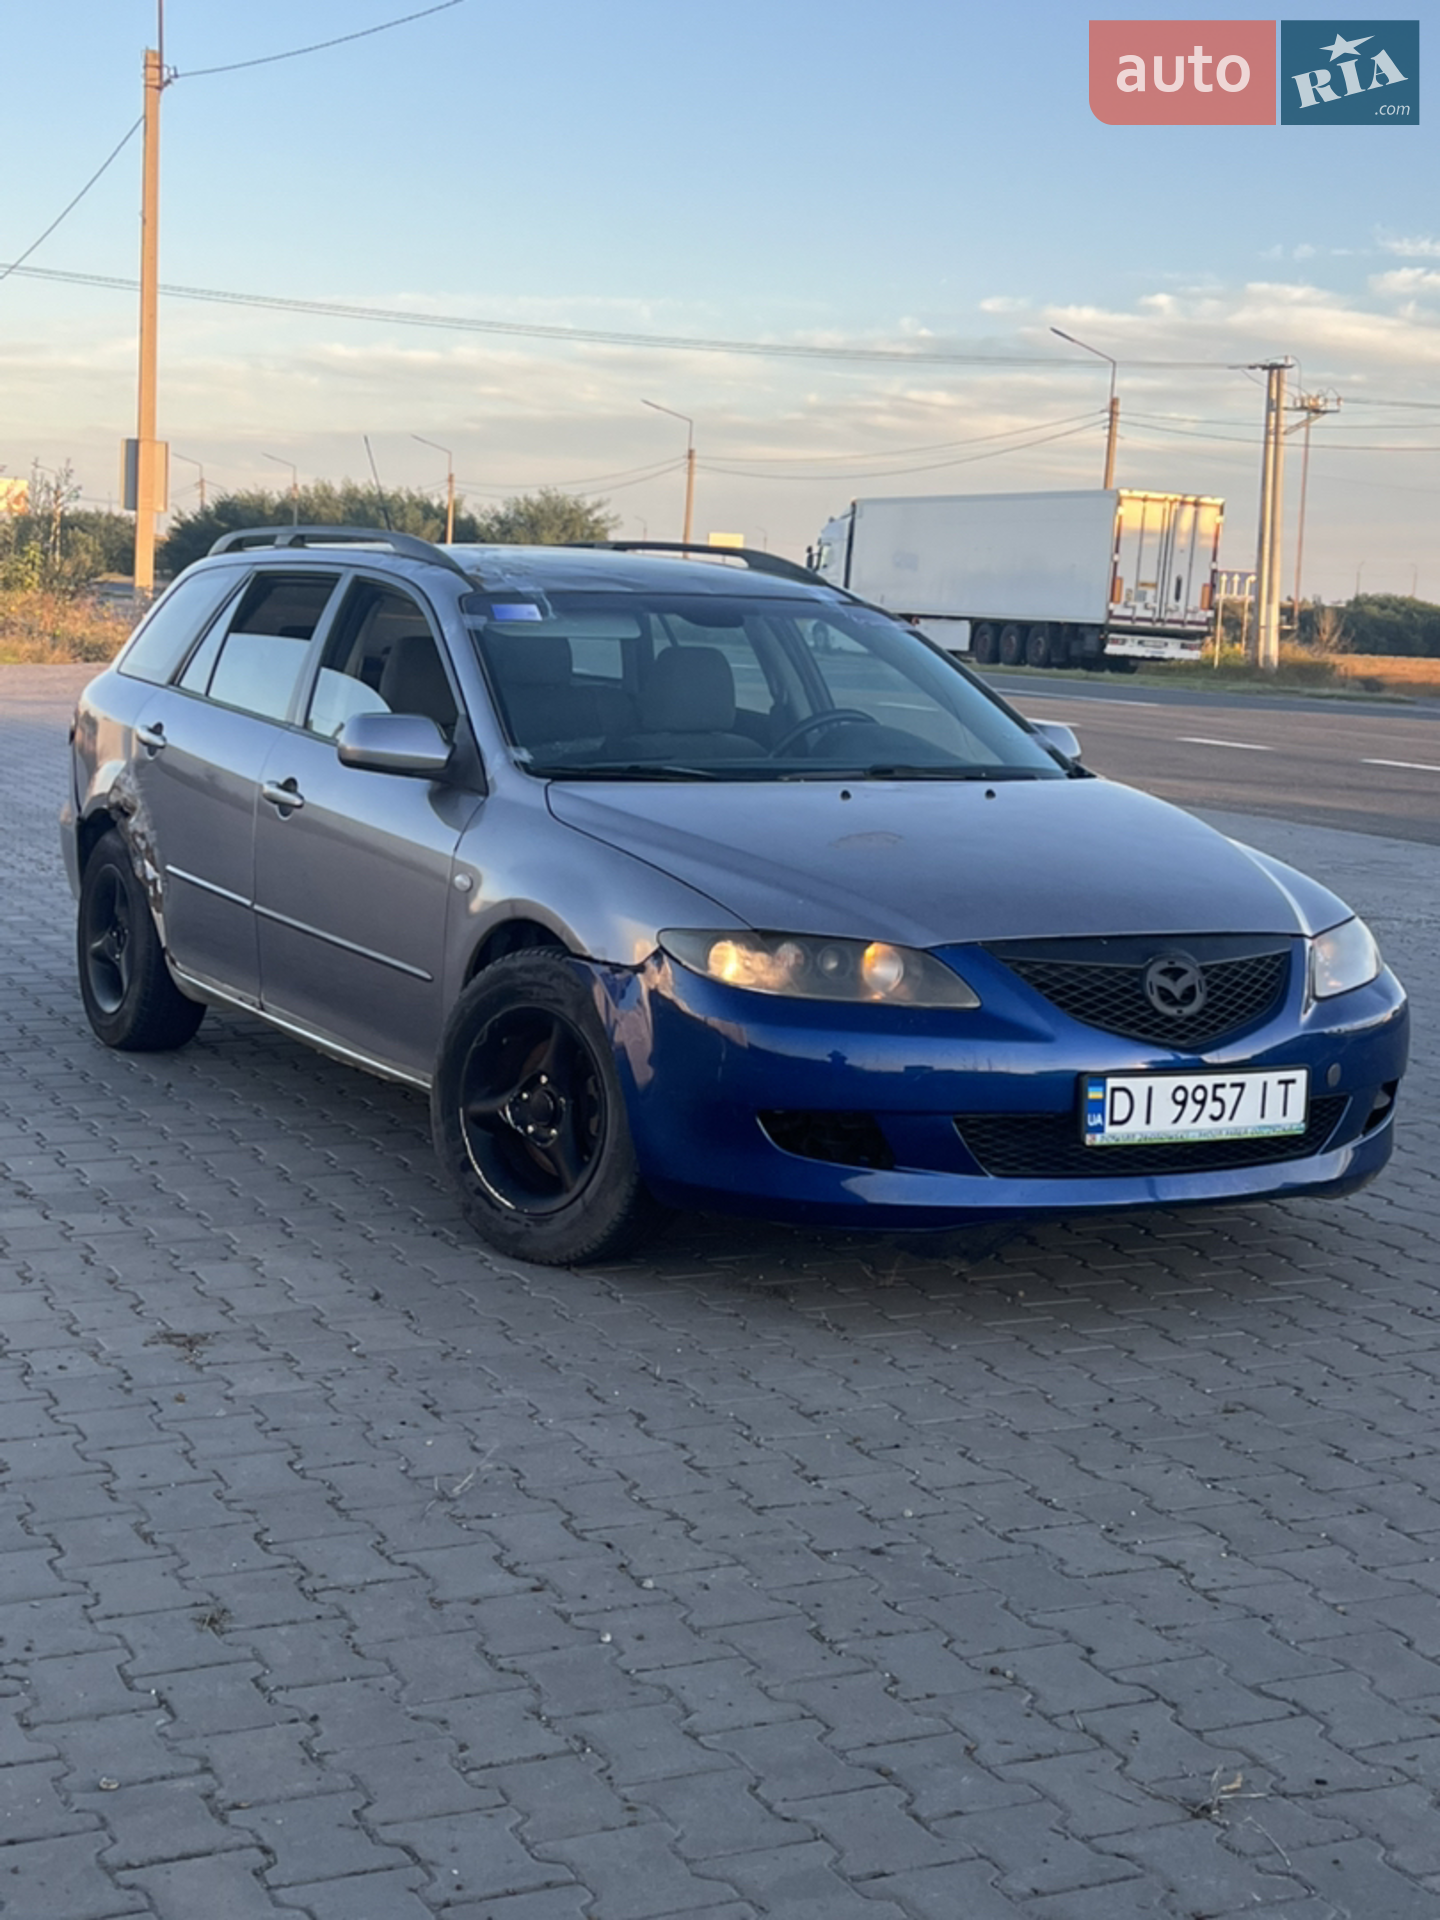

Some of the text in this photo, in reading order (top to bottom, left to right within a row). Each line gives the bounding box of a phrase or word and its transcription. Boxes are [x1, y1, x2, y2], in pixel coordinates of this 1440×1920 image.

[1108, 1078, 1297, 1126] DI 9957 IT
[1087, 1113, 1103, 1126] UA
